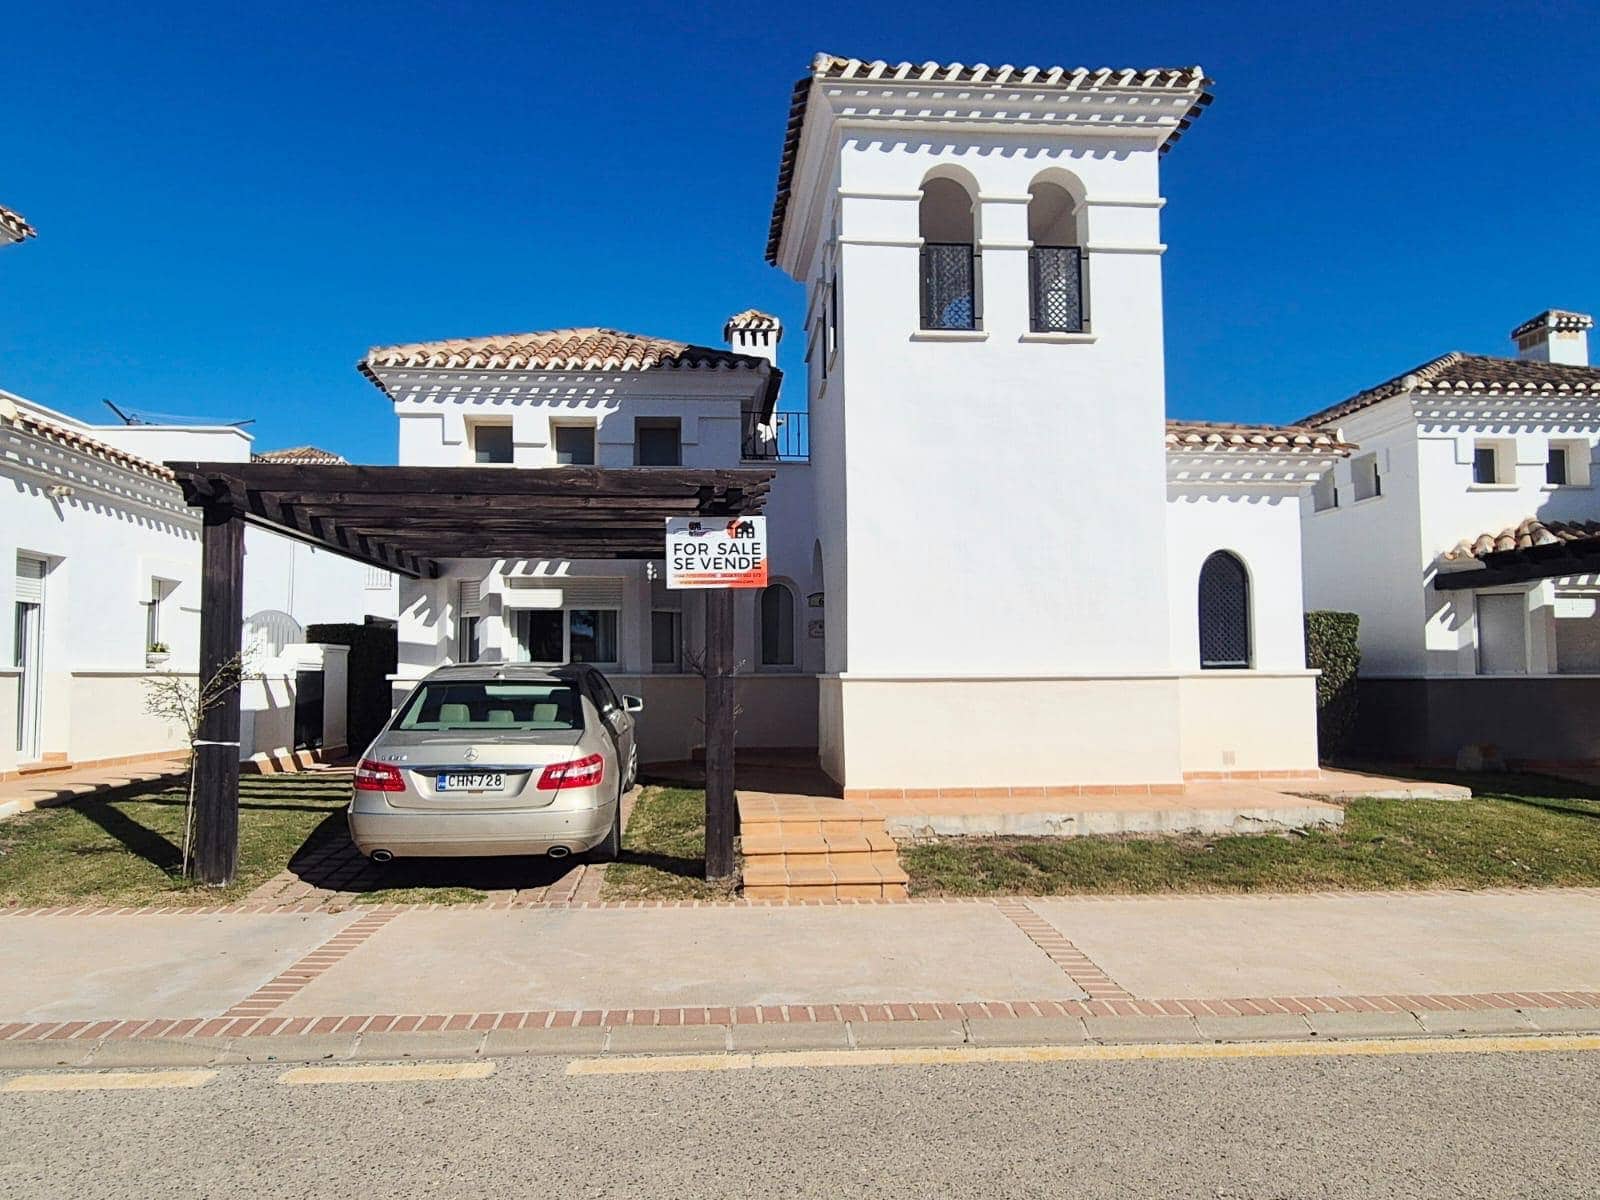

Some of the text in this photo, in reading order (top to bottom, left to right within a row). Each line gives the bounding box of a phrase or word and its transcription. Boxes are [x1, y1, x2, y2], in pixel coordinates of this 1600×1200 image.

[673, 542, 761, 555] FOR SALE
[673, 557, 762, 570] SE VENDE
